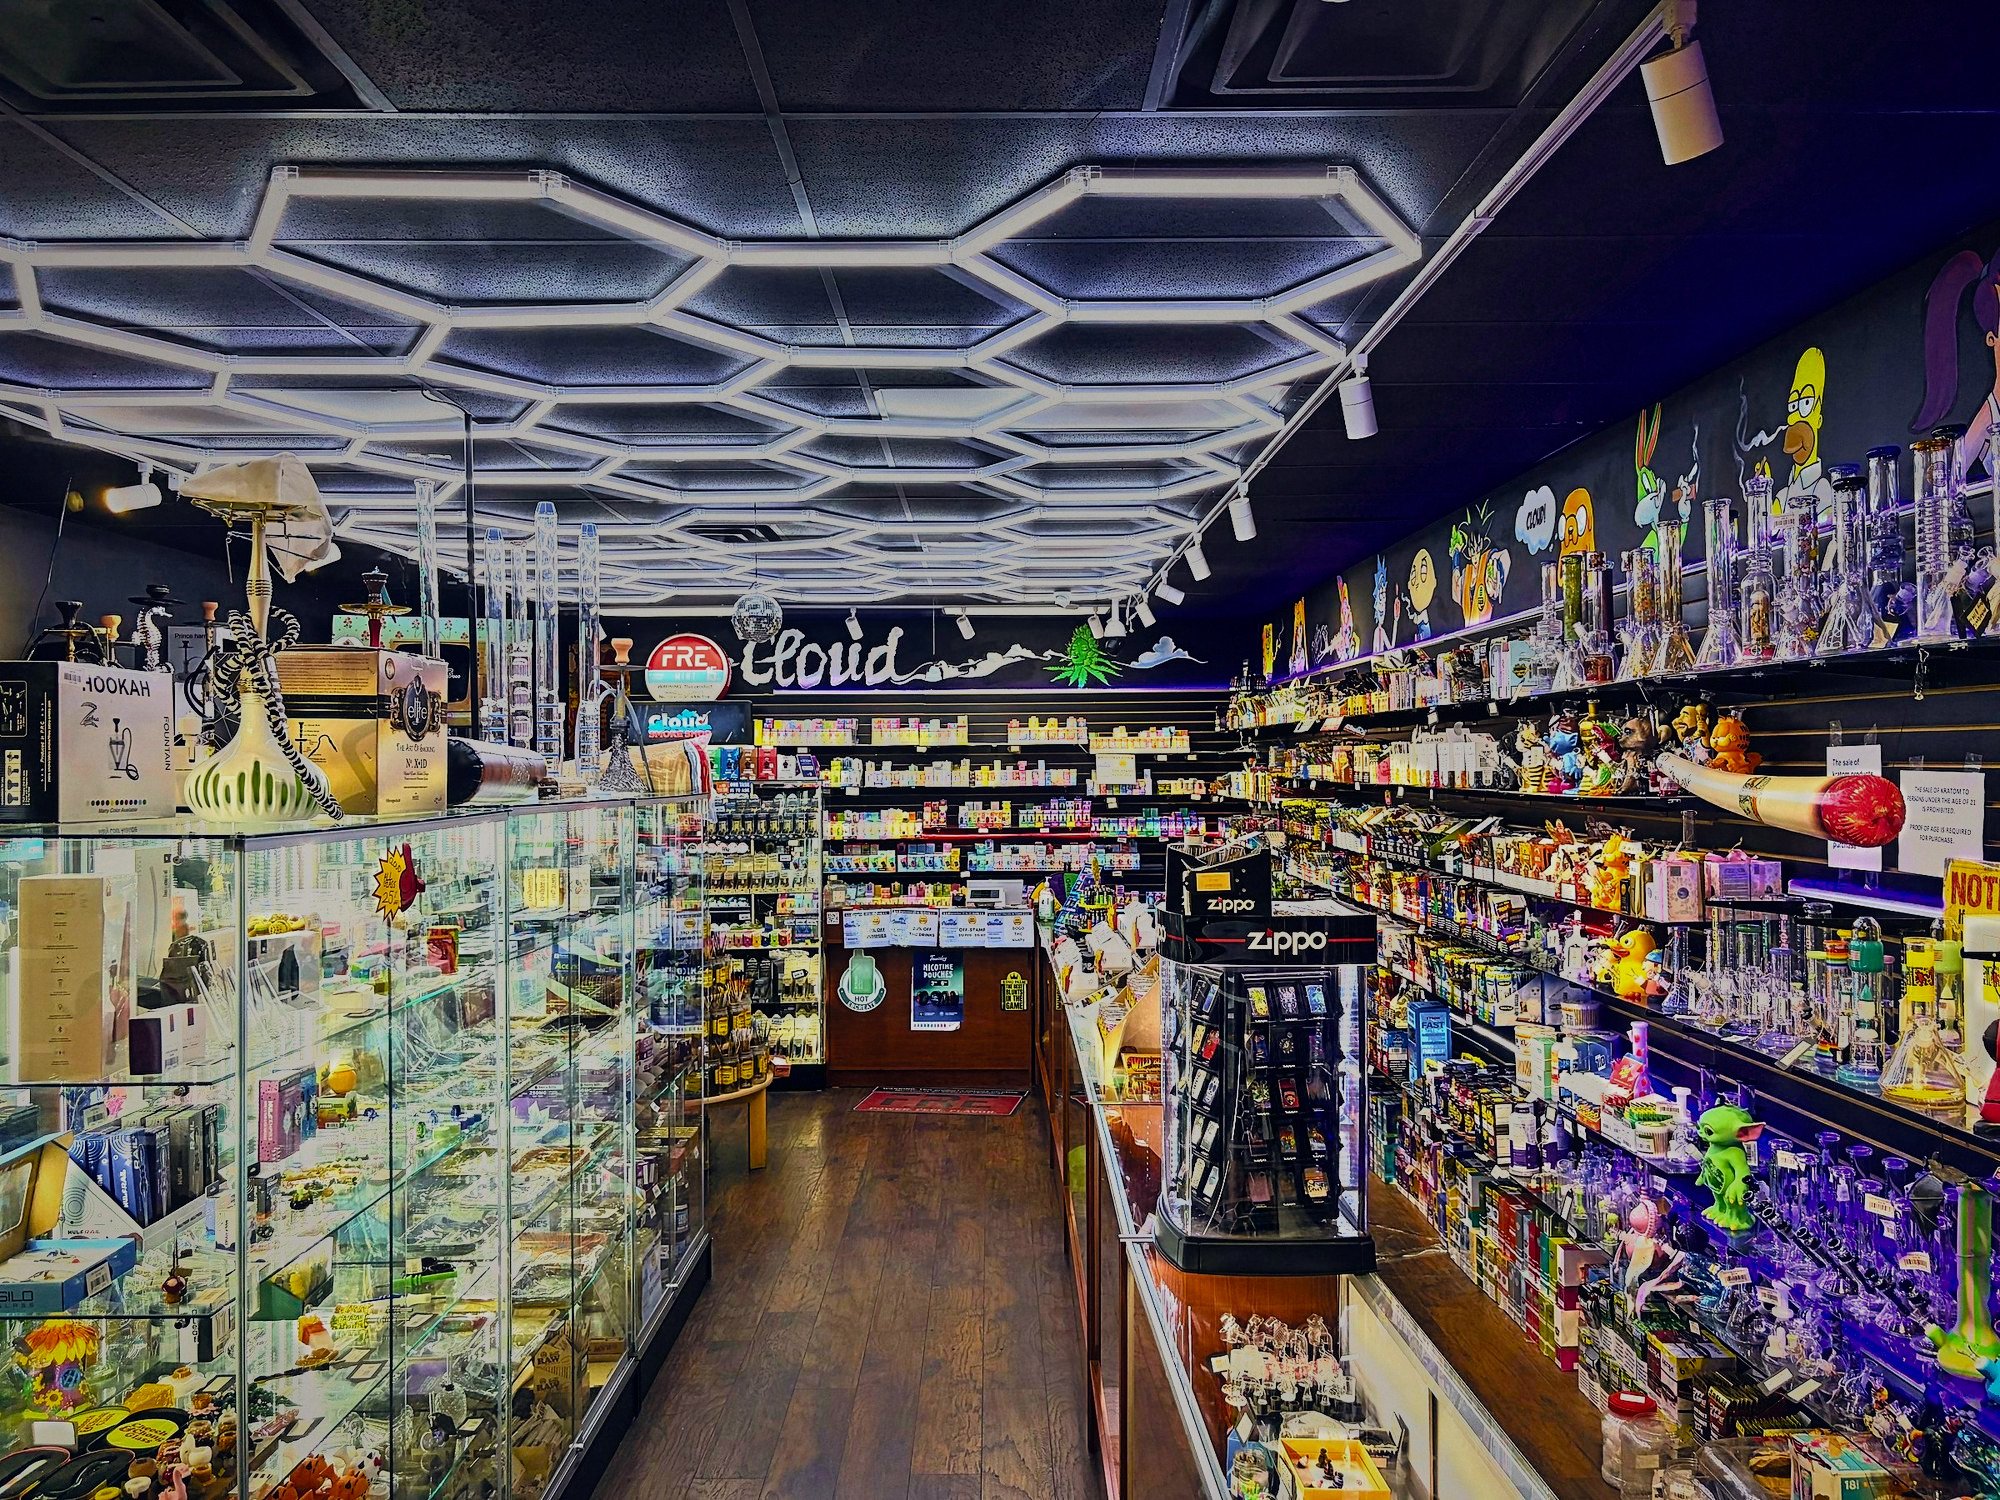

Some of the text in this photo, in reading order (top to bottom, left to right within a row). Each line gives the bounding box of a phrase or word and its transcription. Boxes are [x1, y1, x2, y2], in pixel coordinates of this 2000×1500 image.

[662, 645, 712, 667] FRE
[738, 626, 905, 689] Cloud
[648, 710, 712, 729] Cloud
[163, 715, 172, 771] FOUNTAIN
[1832, 758, 1842, 766] The
[1853, 758, 1860, 766] of
[1907, 795, 1925, 803] PERSONS
[1925, 796, 1941, 804] UNDER
[98, 807, 111, 815] Many
[121, 806, 138, 814] Available
[1910, 823, 1923, 831] PROOF
[1945, 827, 1972, 836] REQUIRED
[1951, 871, 2000, 911] NOT
[922, 963, 954, 971] NICOTINE
[923, 971, 954, 979] POUCHES
[1006, 1002, 1023, 1010] GAME
[1422, 1021, 1445, 1029] FAST
[519, 1219, 548, 1229] IRENE'S
[537, 1353, 560, 1366] RAW
[536, 1379, 560, 1392] RAW
[131, 1422, 168, 1437] Cheech
[124, 1432, 153, 1444] Glass
